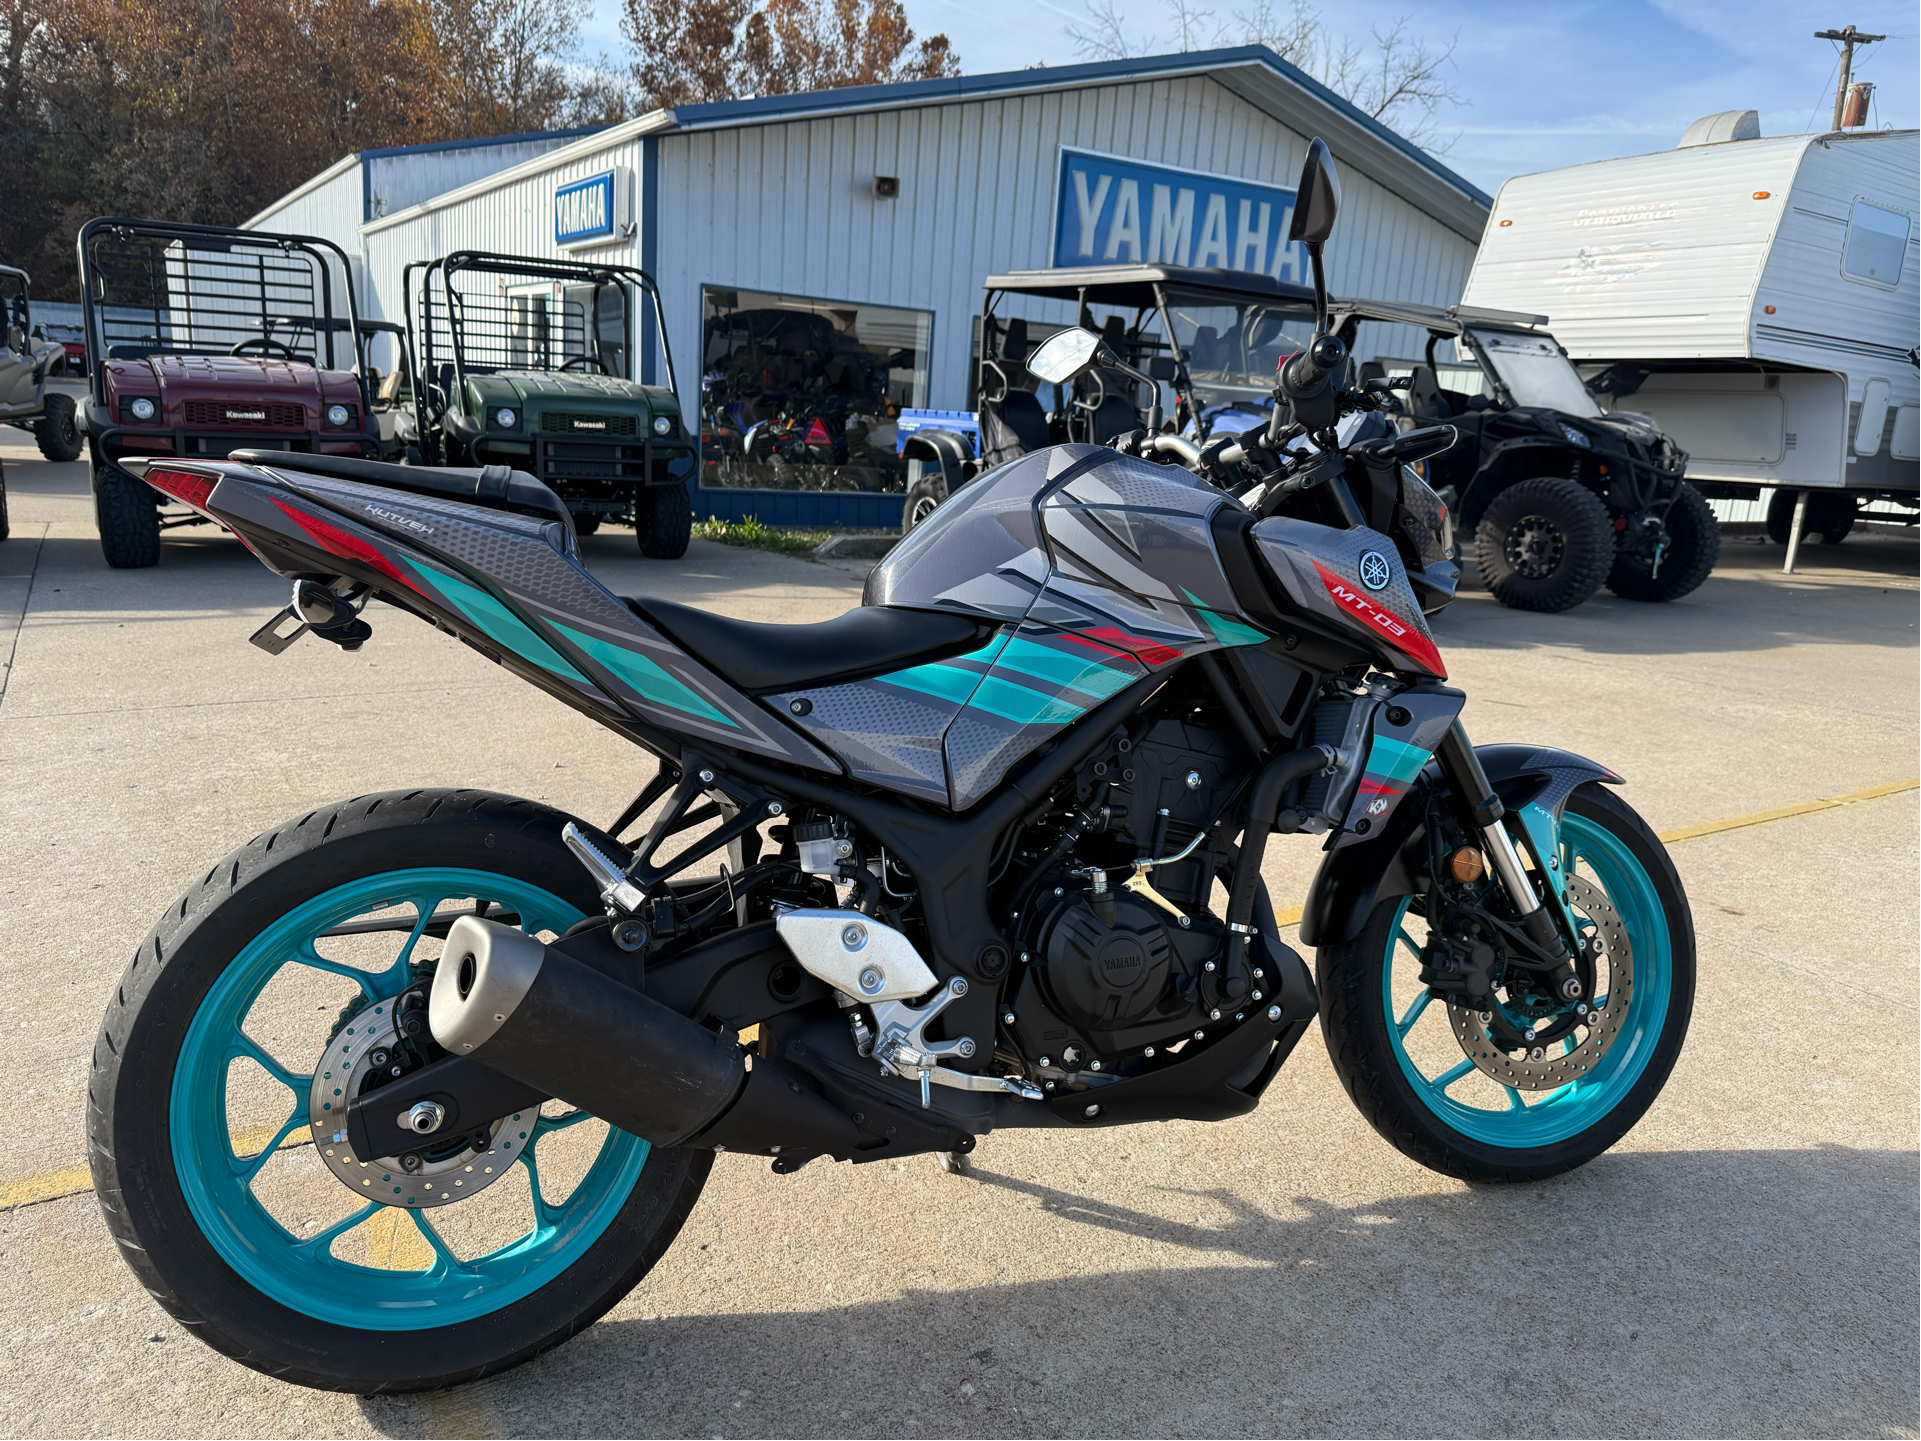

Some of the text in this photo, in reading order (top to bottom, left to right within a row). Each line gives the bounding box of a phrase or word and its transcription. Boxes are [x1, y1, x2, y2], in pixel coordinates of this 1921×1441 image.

[556, 183, 606, 236] YAMAHA
[1072, 170, 1301, 284] YAMAHA
[225, 410, 266, 420] Kawasaki
[573, 420, 606, 429] Kawasaki
[1331, 585, 1407, 637] MT-03
[1104, 955, 1142, 971] YAMAHA
